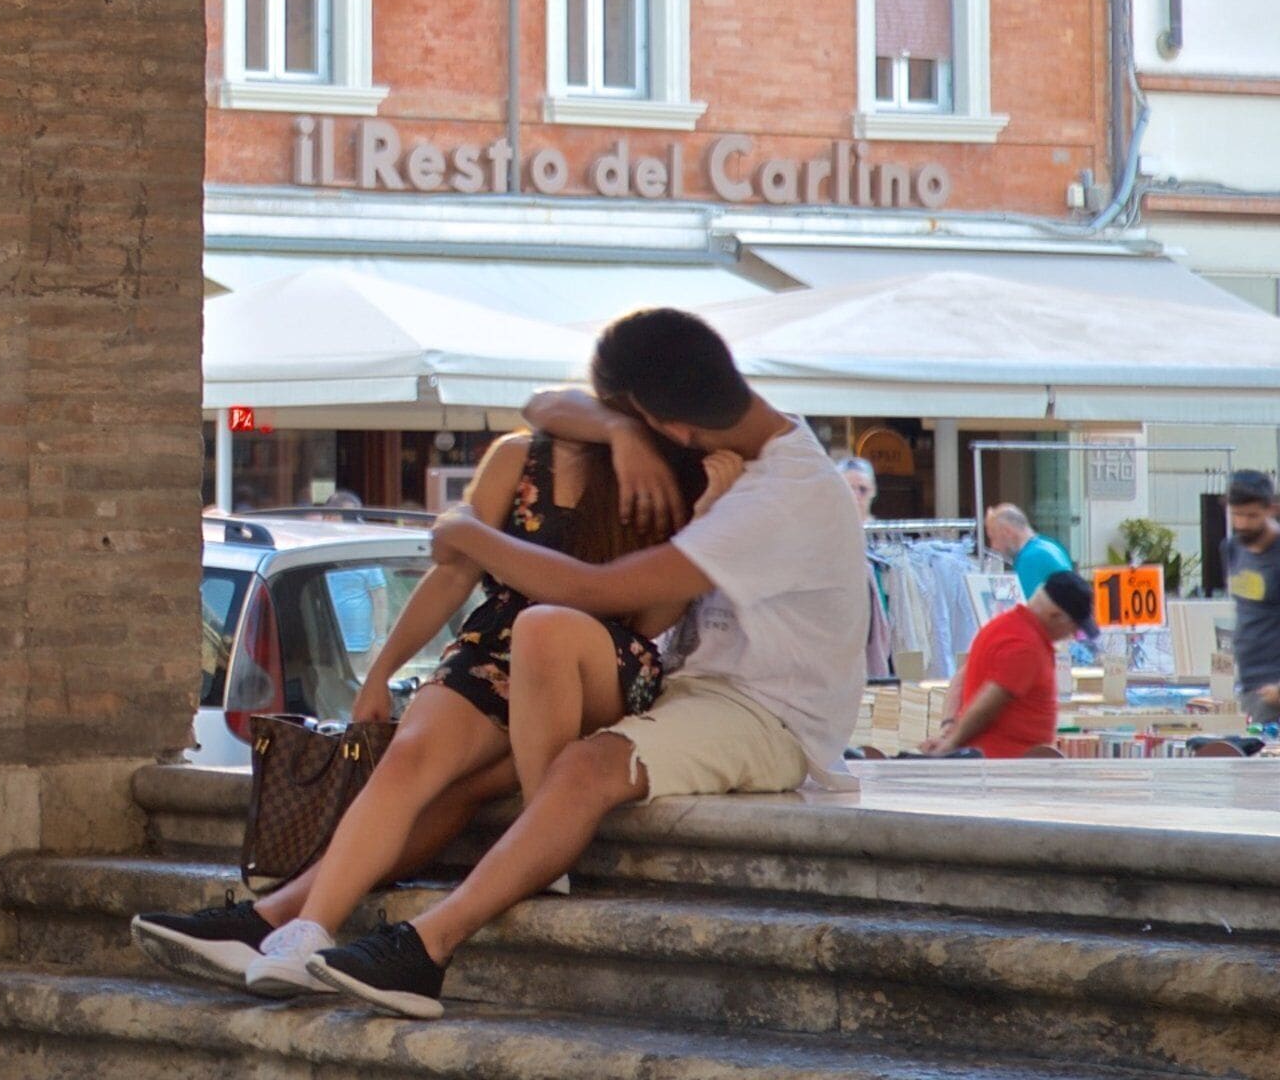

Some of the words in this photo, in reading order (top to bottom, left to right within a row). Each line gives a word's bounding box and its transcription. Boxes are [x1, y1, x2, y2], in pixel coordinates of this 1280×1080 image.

[296, 115, 335, 186] il
[360, 119, 569, 194] Resto
[593, 135, 683, 199] del
[708, 133, 951, 209] Carlino
[1098, 574, 1157, 624] 1.00
